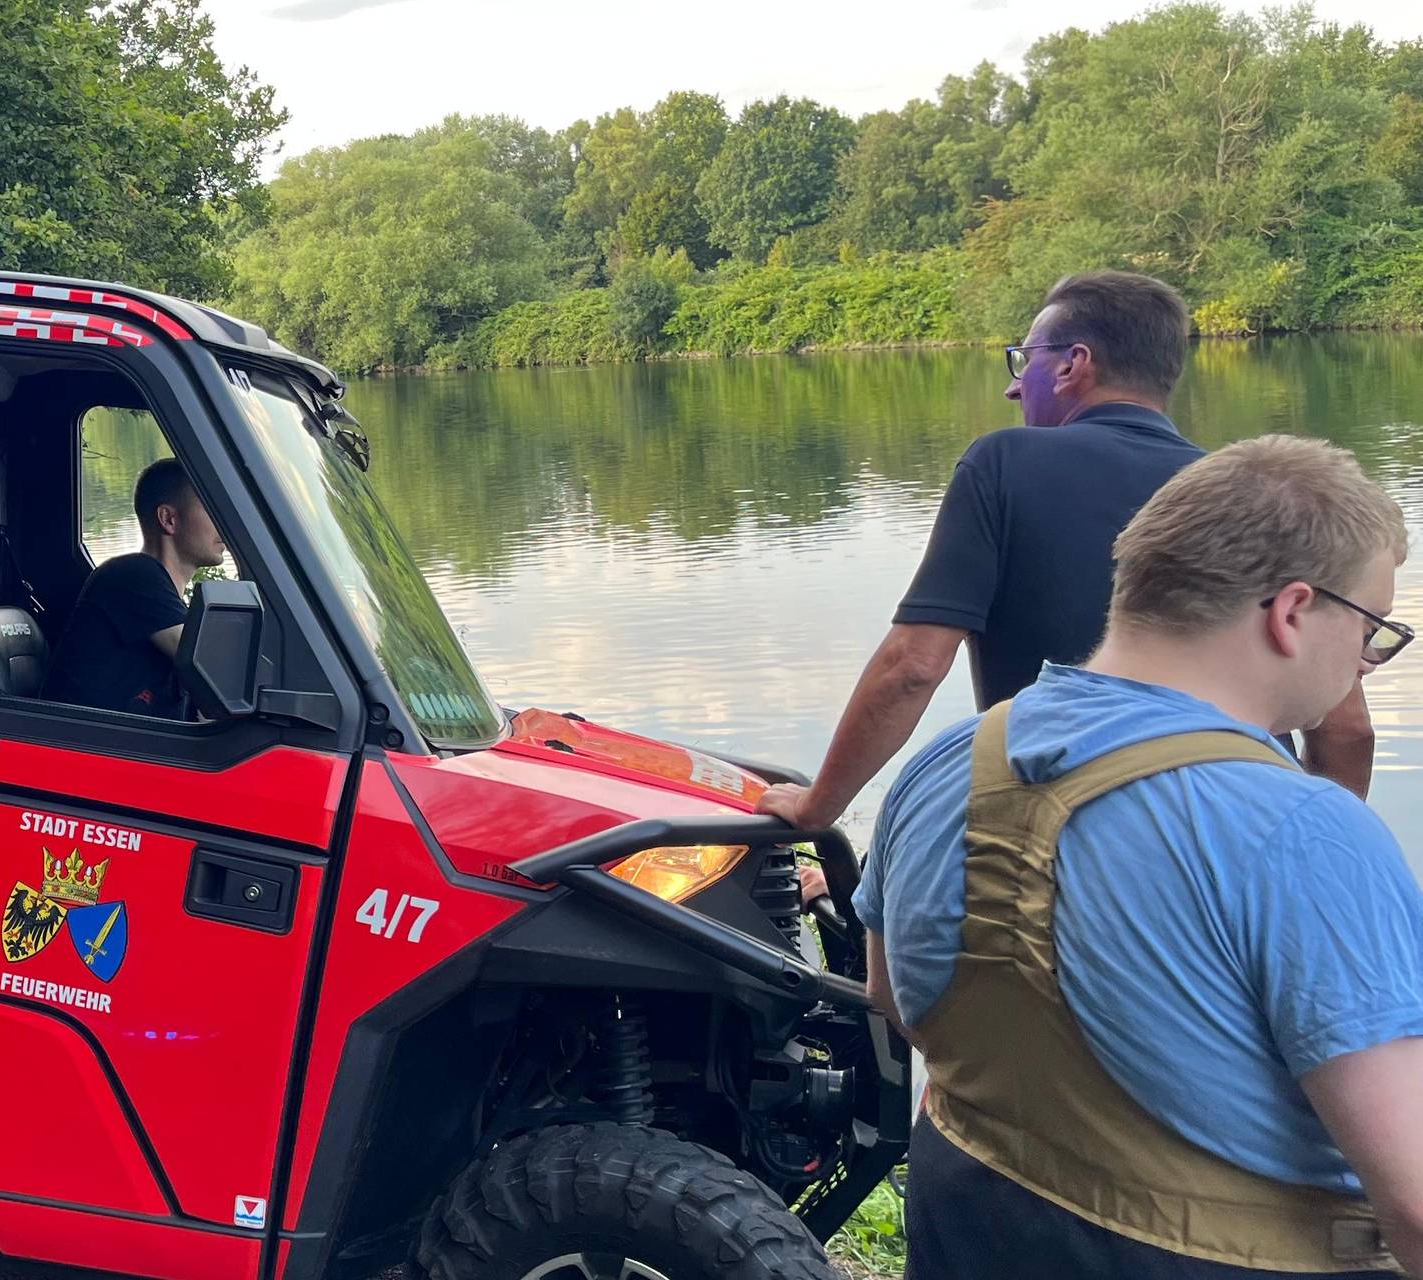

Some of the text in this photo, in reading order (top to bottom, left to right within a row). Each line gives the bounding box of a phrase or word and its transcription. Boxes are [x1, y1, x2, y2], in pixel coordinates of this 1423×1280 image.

[0, 623, 31, 637] POLARIS
[19, 811, 142, 851] STADT ESSEN
[482, 862, 498, 878] 1.0
[355, 888, 440, 944] 4/7
[0, 972, 112, 1013] FEUERWEHR
